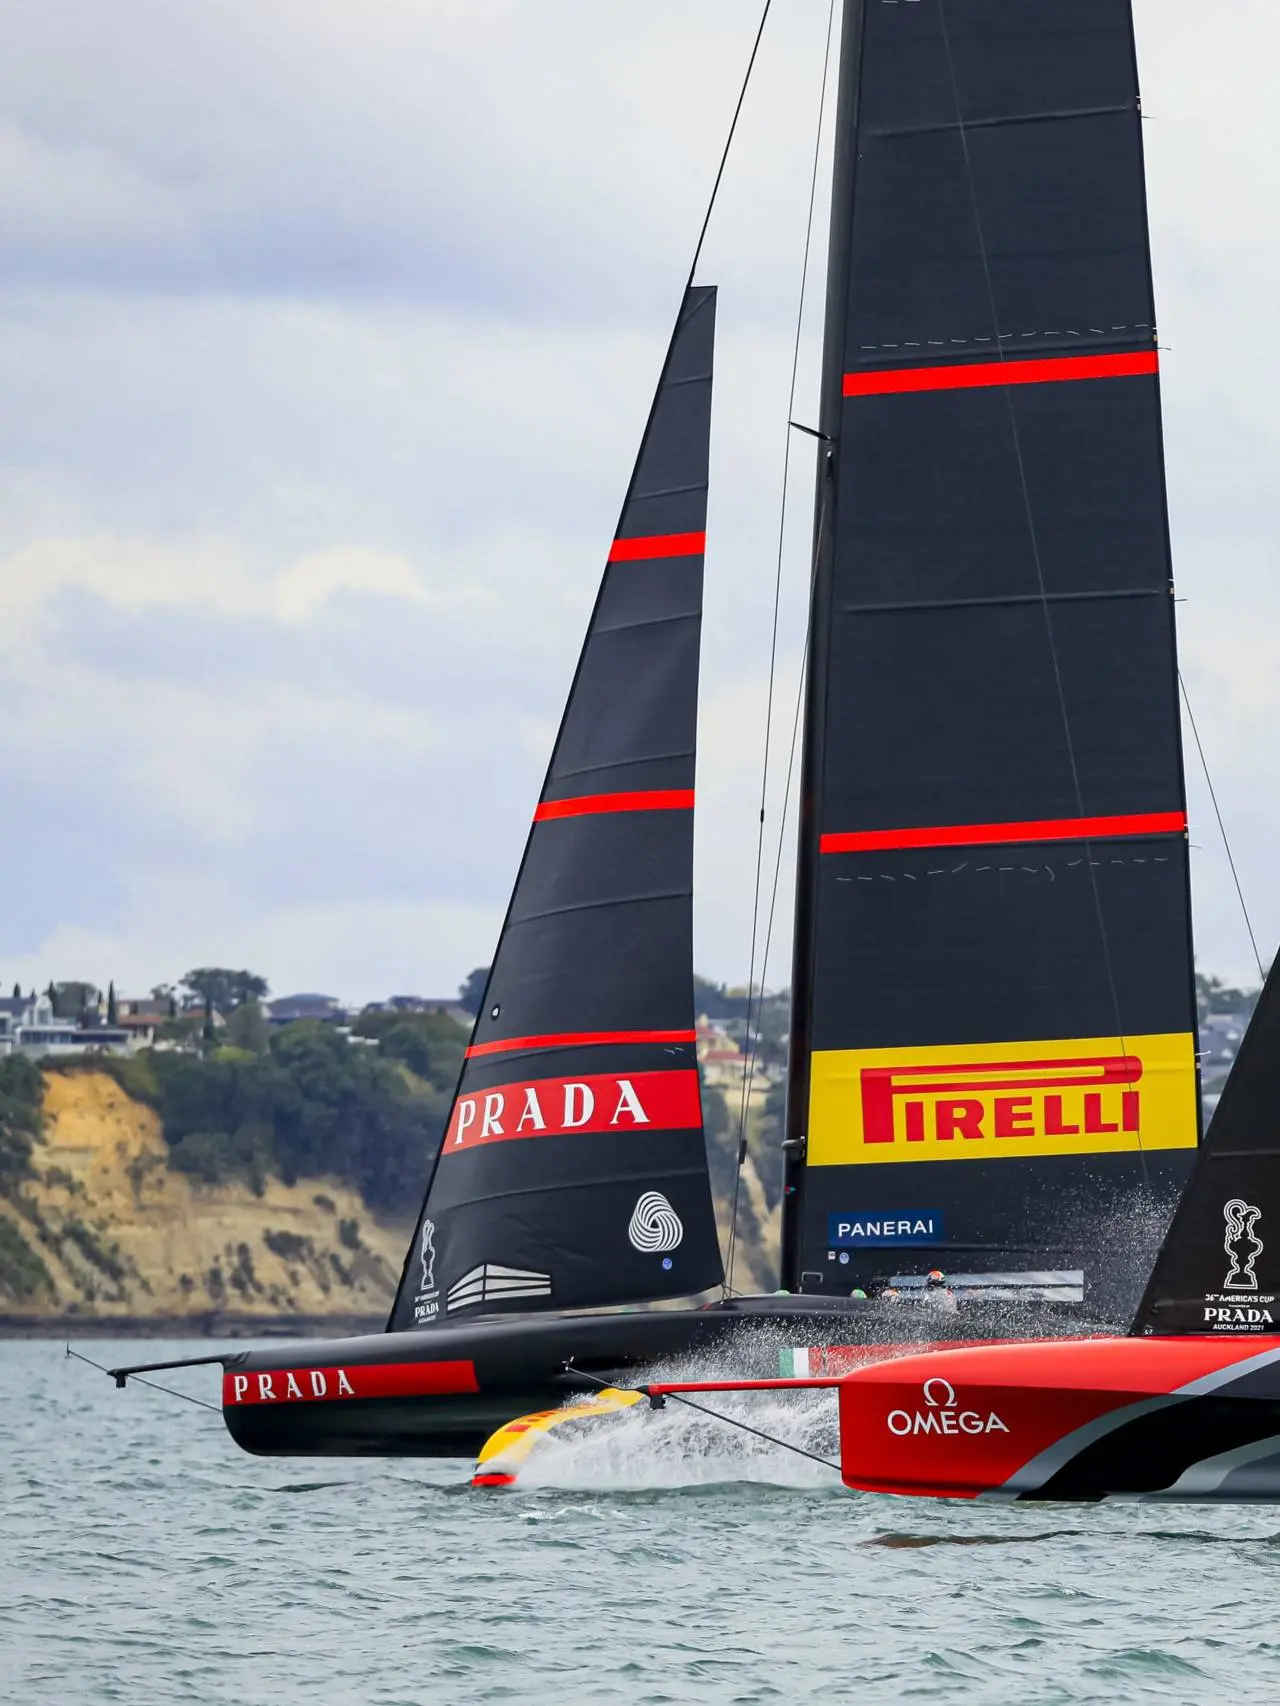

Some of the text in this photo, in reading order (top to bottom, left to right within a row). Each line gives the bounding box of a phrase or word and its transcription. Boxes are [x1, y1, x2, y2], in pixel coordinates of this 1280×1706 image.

[860, 1056, 1144, 1144] PIRELLI
[453, 1079, 651, 1145] PRADA
[838, 1220, 933, 1237] PANERAI
[1259, 1295, 1275, 1303] CUP
[1203, 1307, 1274, 1323] PRADA
[1212, 1323, 1249, 1331] AUCKLAND
[233, 1368, 355, 1402] PRADA
[887, 1409, 1010, 1436] OMEGA
